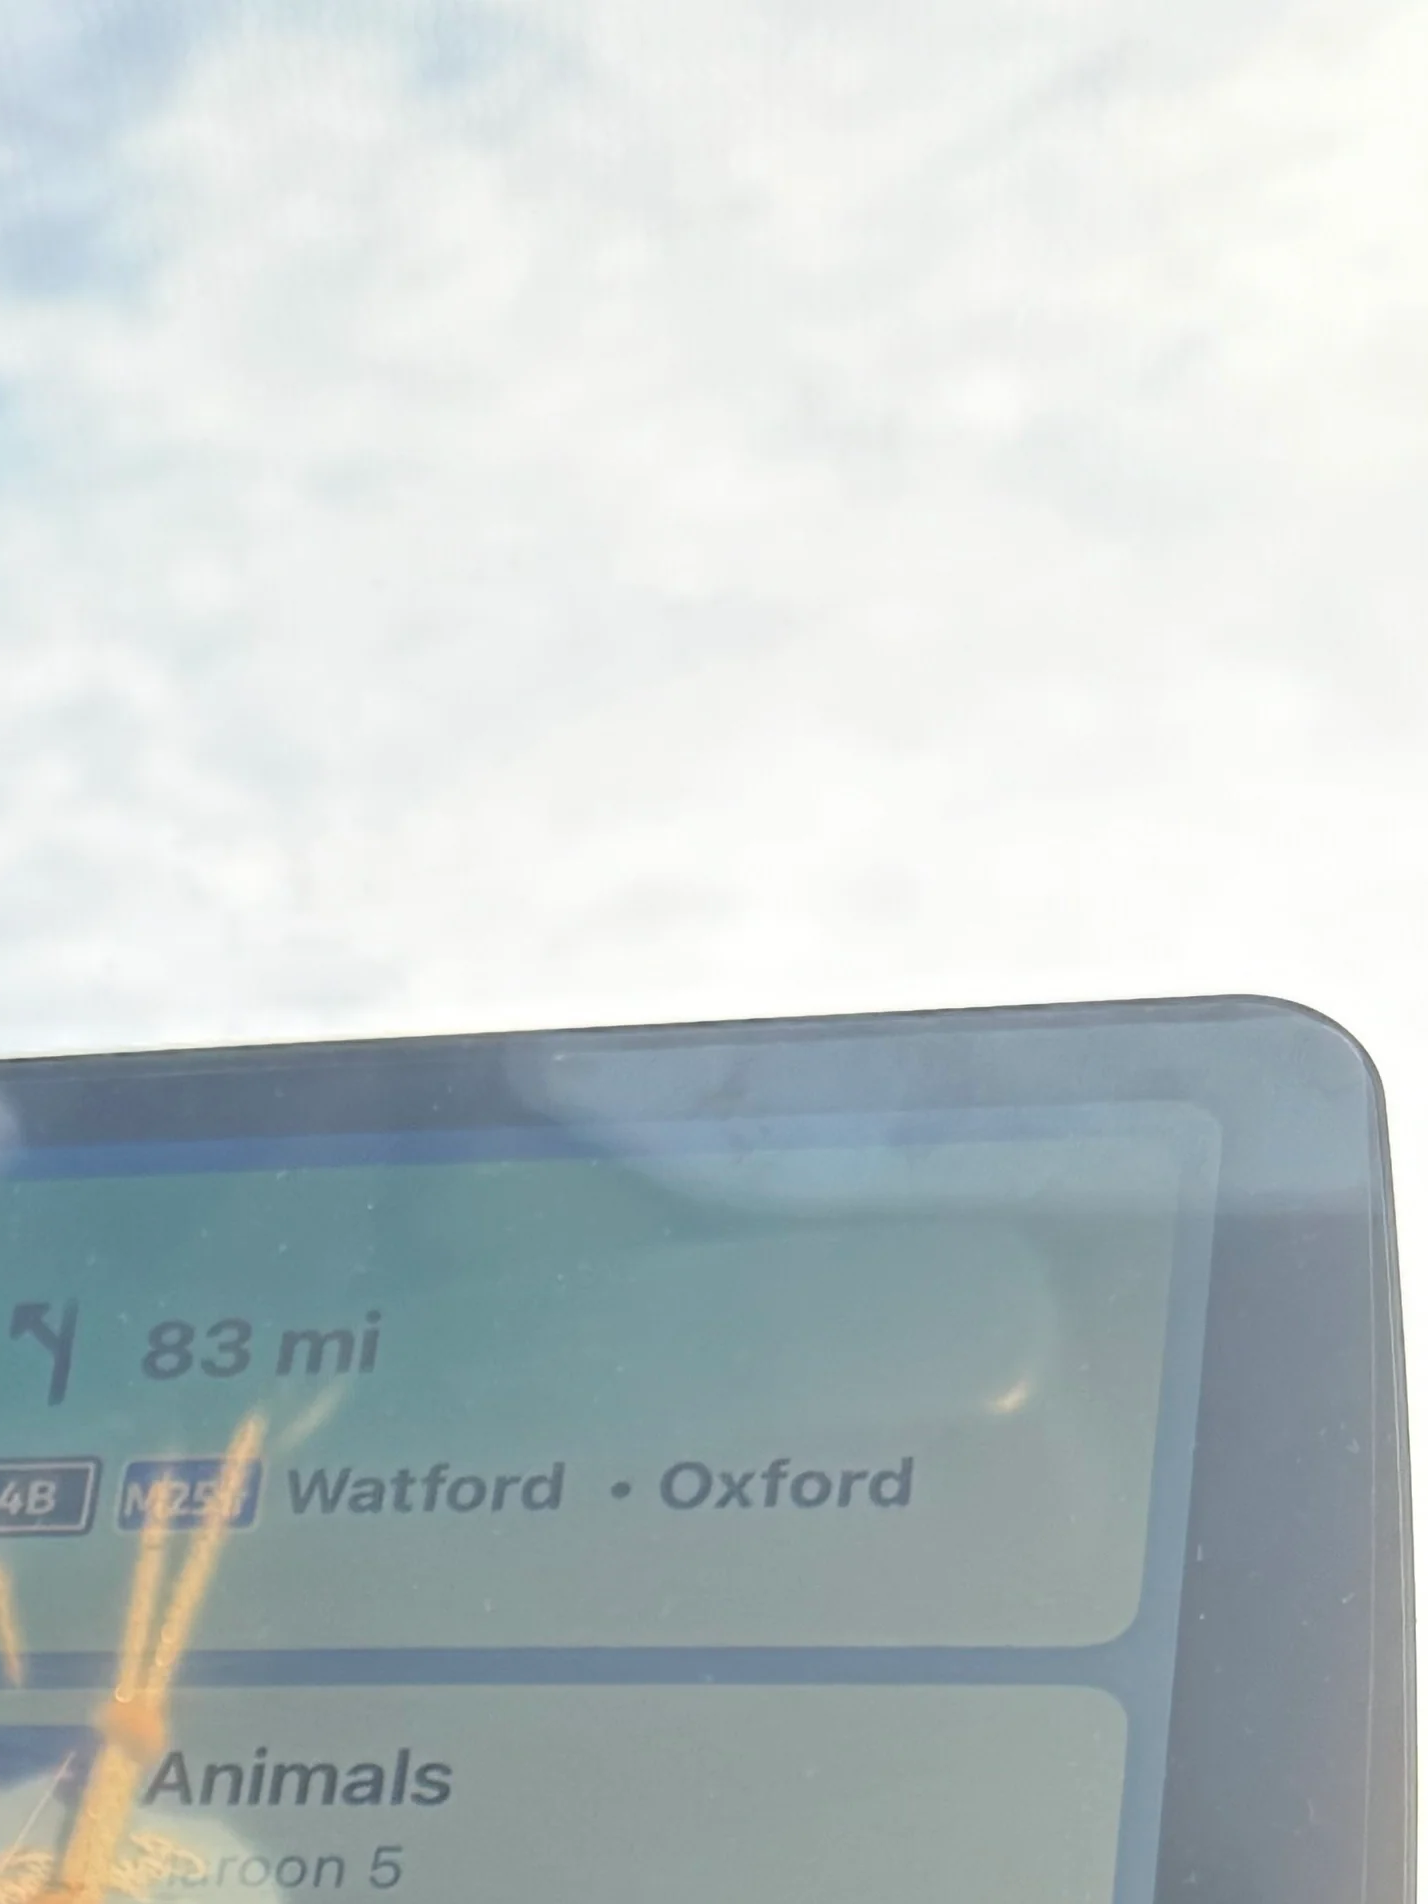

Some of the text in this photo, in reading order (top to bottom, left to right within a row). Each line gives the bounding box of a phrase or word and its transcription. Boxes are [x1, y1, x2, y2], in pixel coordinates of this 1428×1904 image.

[141, 1309, 382, 1380] 83 mi
[287, 1461, 566, 1515] Watford
[659, 1457, 914, 1511] Oxford
[143, 1747, 453, 1807] Animals
[368, 1845, 404, 1890] 5
